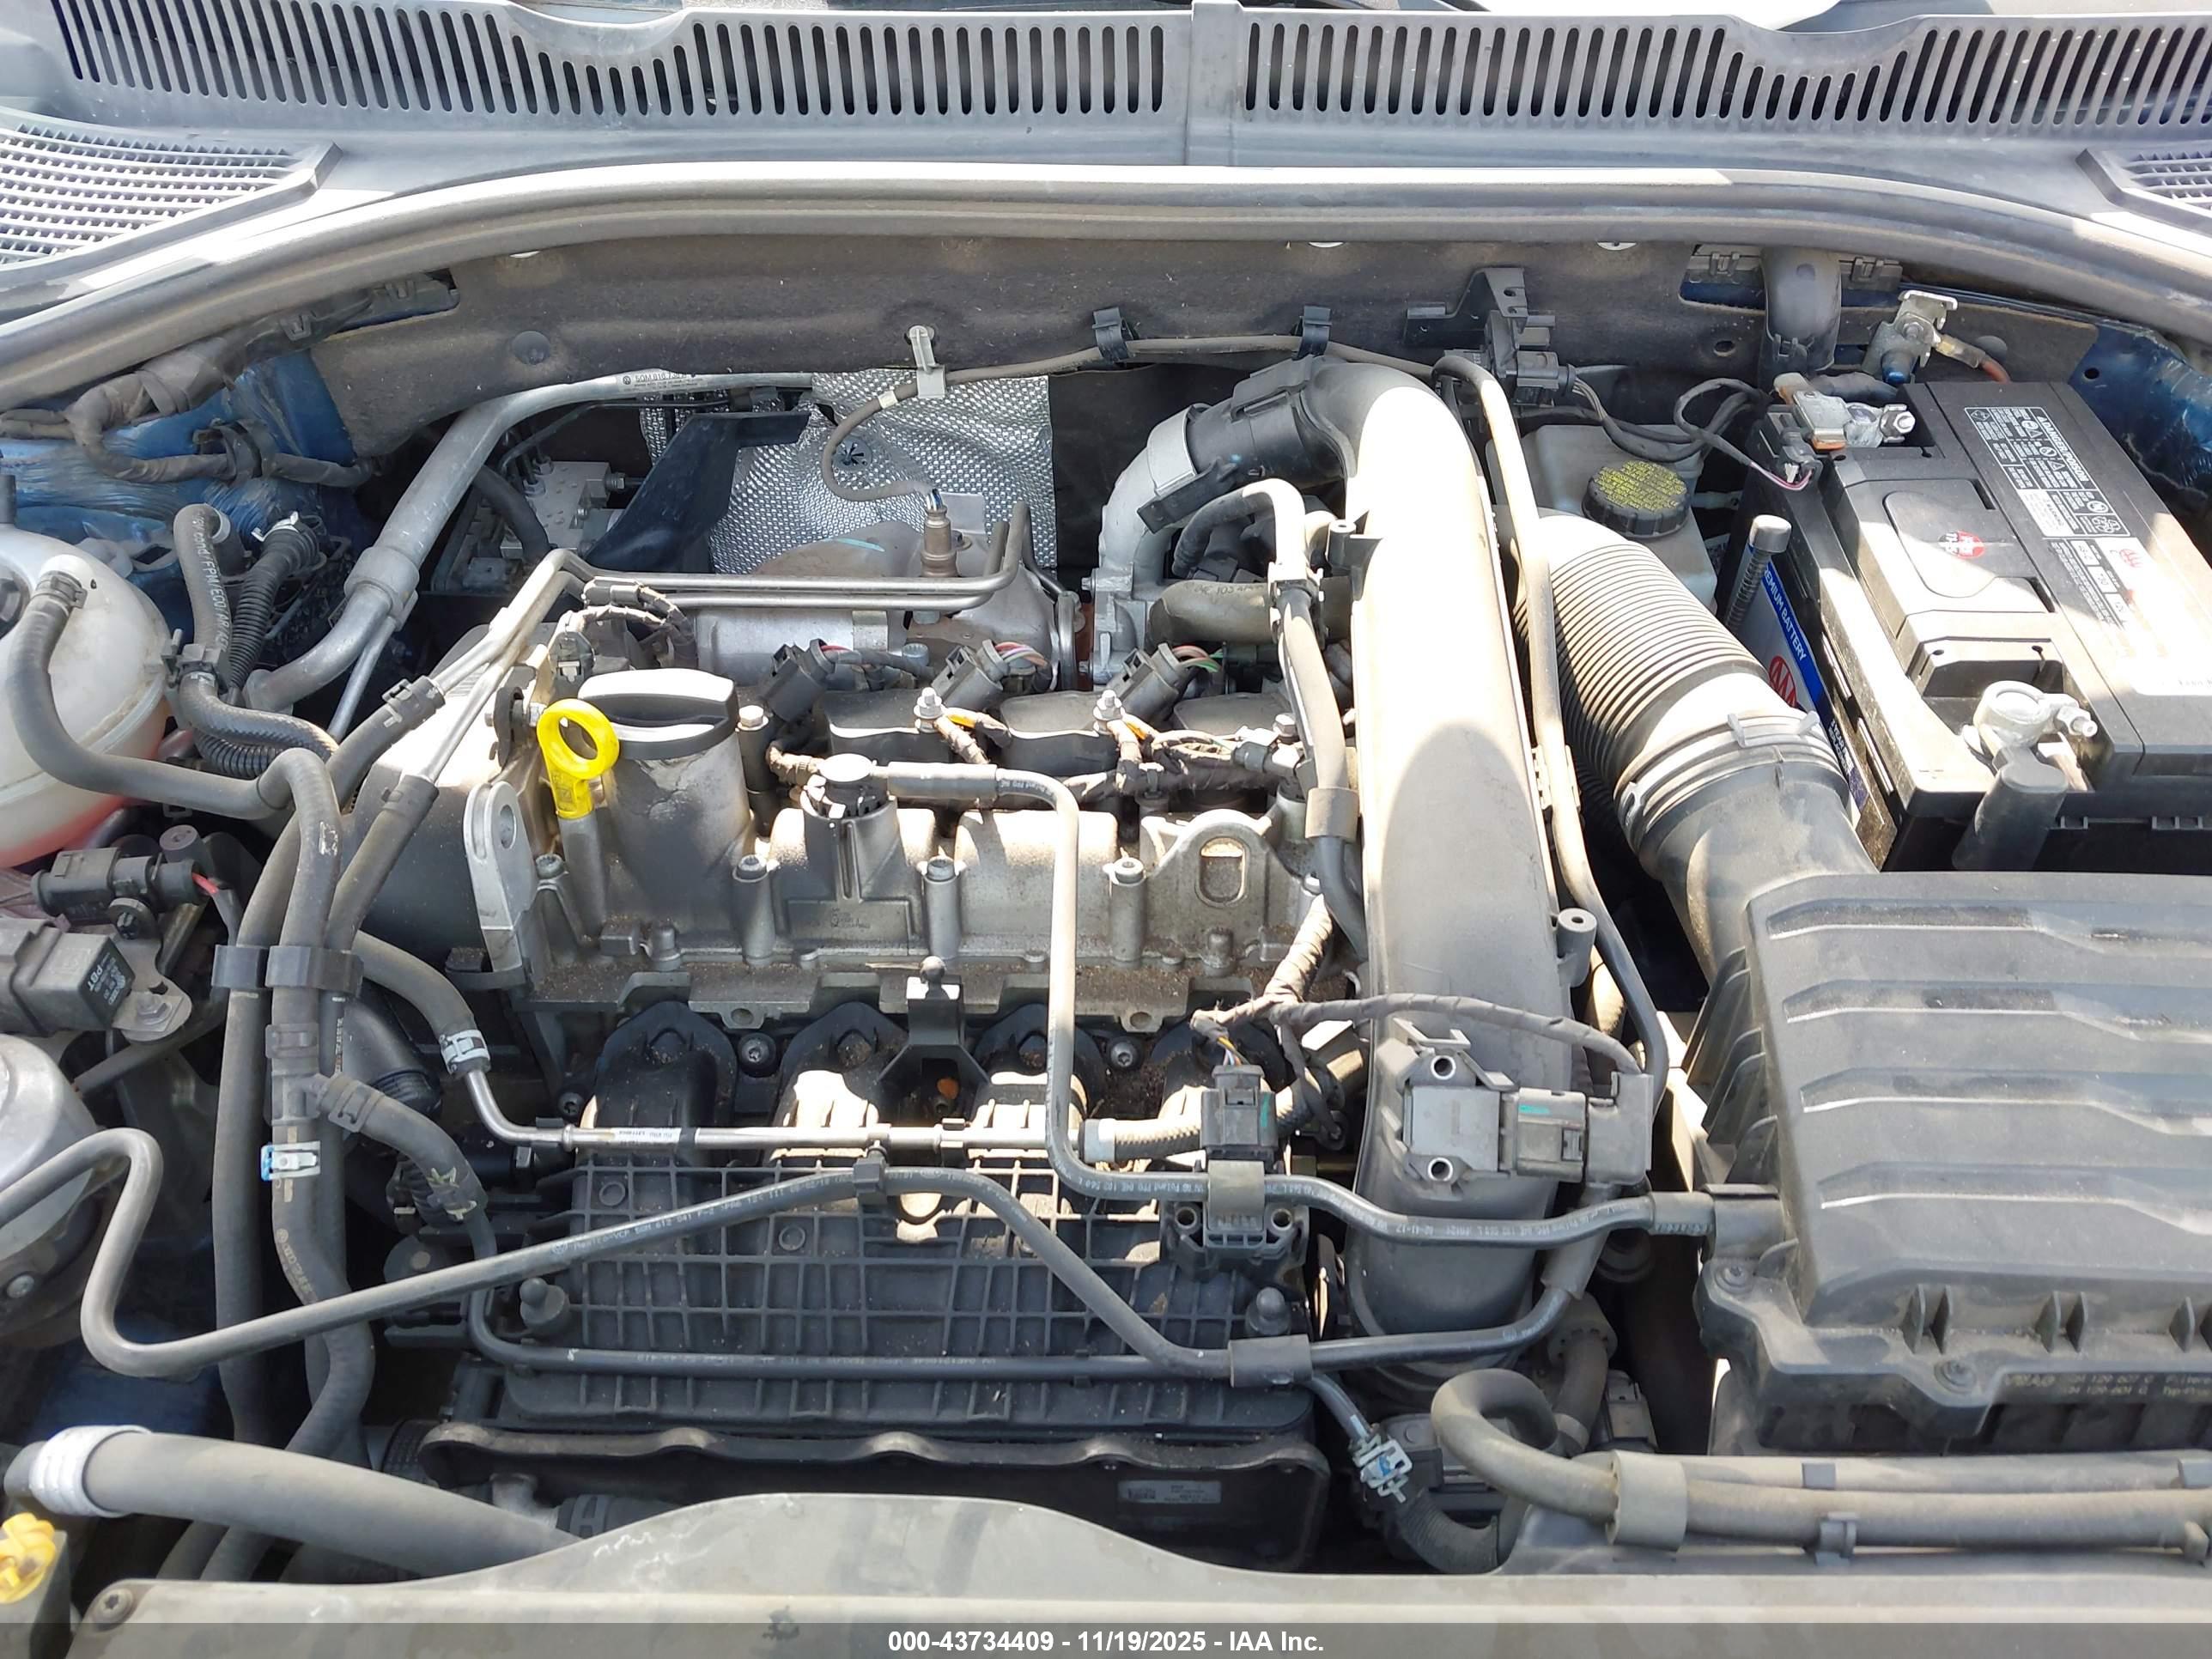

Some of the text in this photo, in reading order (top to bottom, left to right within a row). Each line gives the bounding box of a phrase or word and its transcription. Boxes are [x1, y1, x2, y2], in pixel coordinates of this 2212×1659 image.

[2042, 419, 2089, 483] DANGER/POISON
[1764, 567, 1807, 661] EMIUM BATTERY
[87, 963, 103, 992] PBT
[1153, 1182, 1180, 1193] Poland
